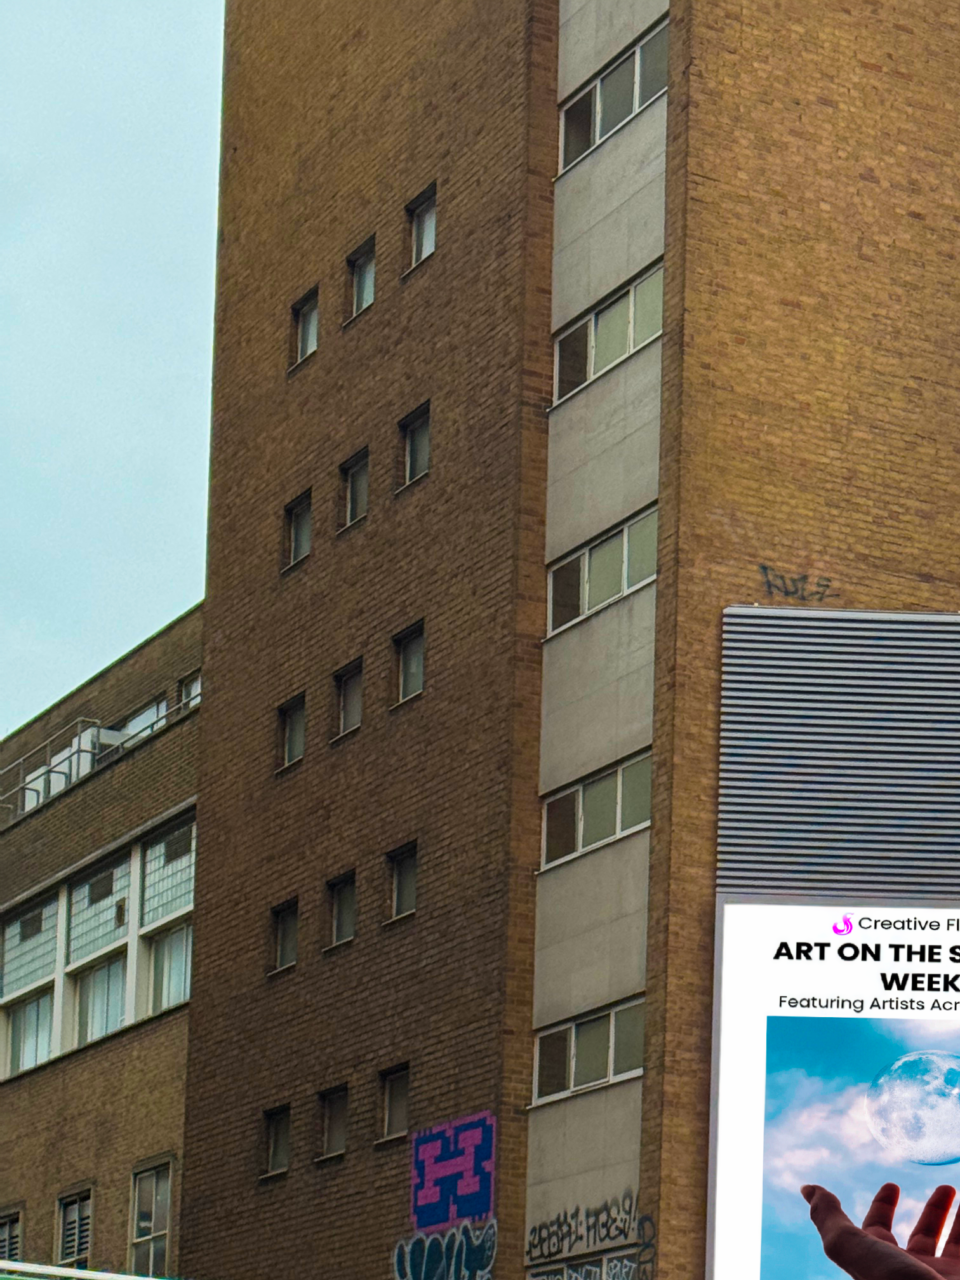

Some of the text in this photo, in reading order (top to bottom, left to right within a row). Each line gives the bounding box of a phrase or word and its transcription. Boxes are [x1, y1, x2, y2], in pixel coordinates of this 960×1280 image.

[858, 916, 941, 932] Creative
[773, 941, 831, 961] ART
[837, 942, 881, 962] ON
[888, 943, 942, 963] THE
[779, 995, 864, 1013] Featuring
[869, 997, 926, 1011] Artists
